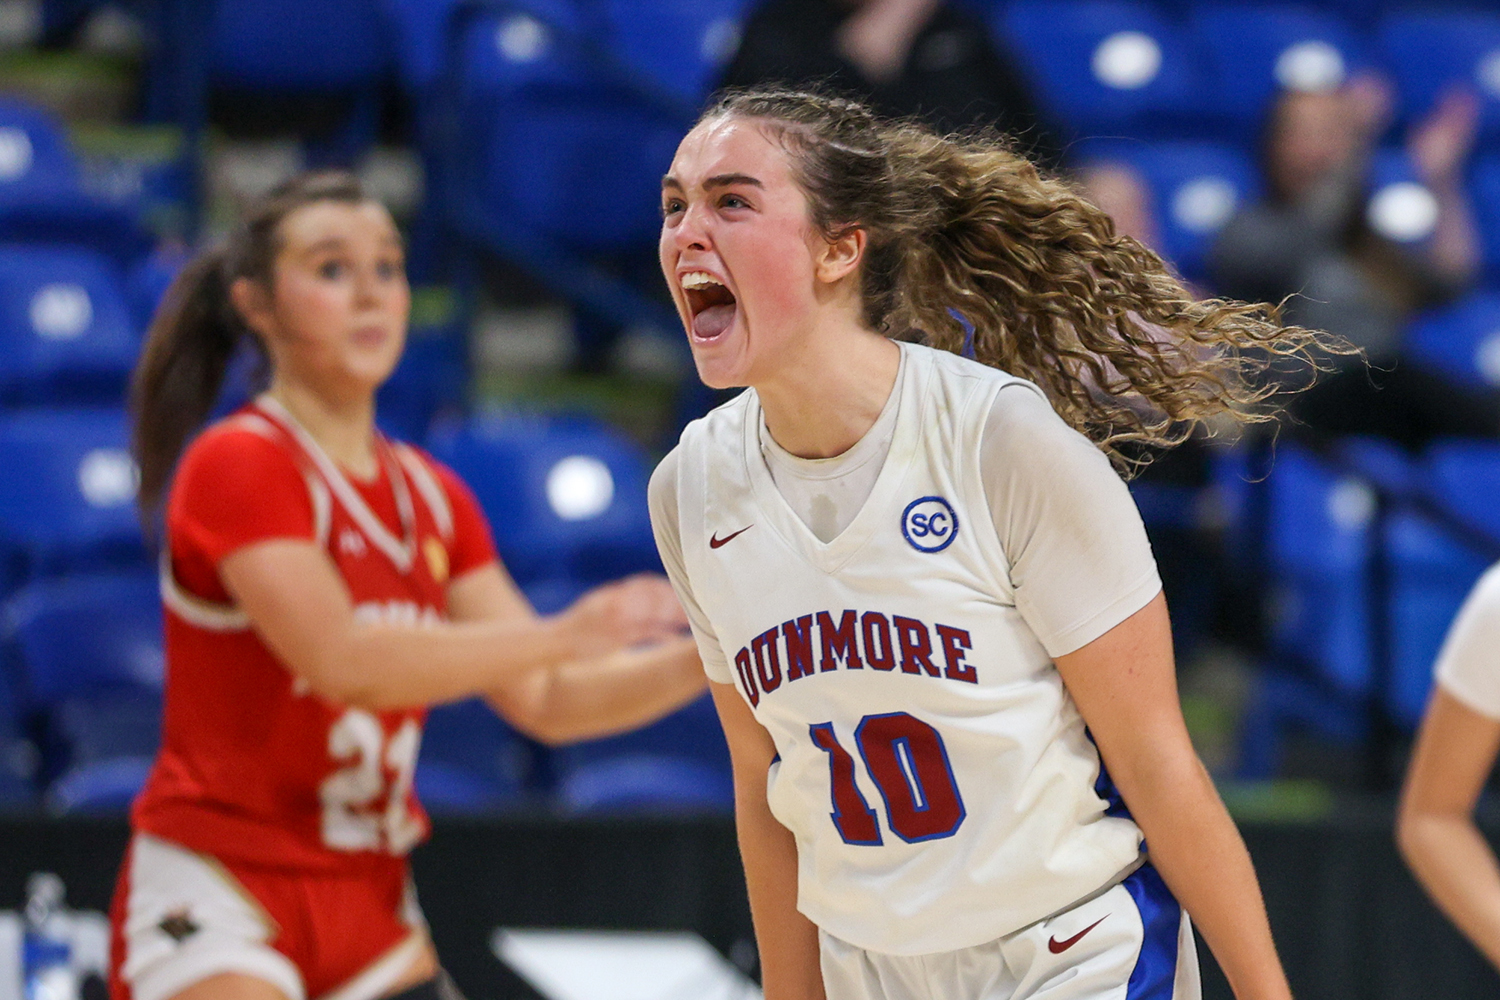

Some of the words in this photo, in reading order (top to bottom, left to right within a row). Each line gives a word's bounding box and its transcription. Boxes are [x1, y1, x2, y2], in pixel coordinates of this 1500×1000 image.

[911, 512, 949, 537] SC
[735, 608, 979, 710] DUNMORE
[808, 711, 967, 847] 10
